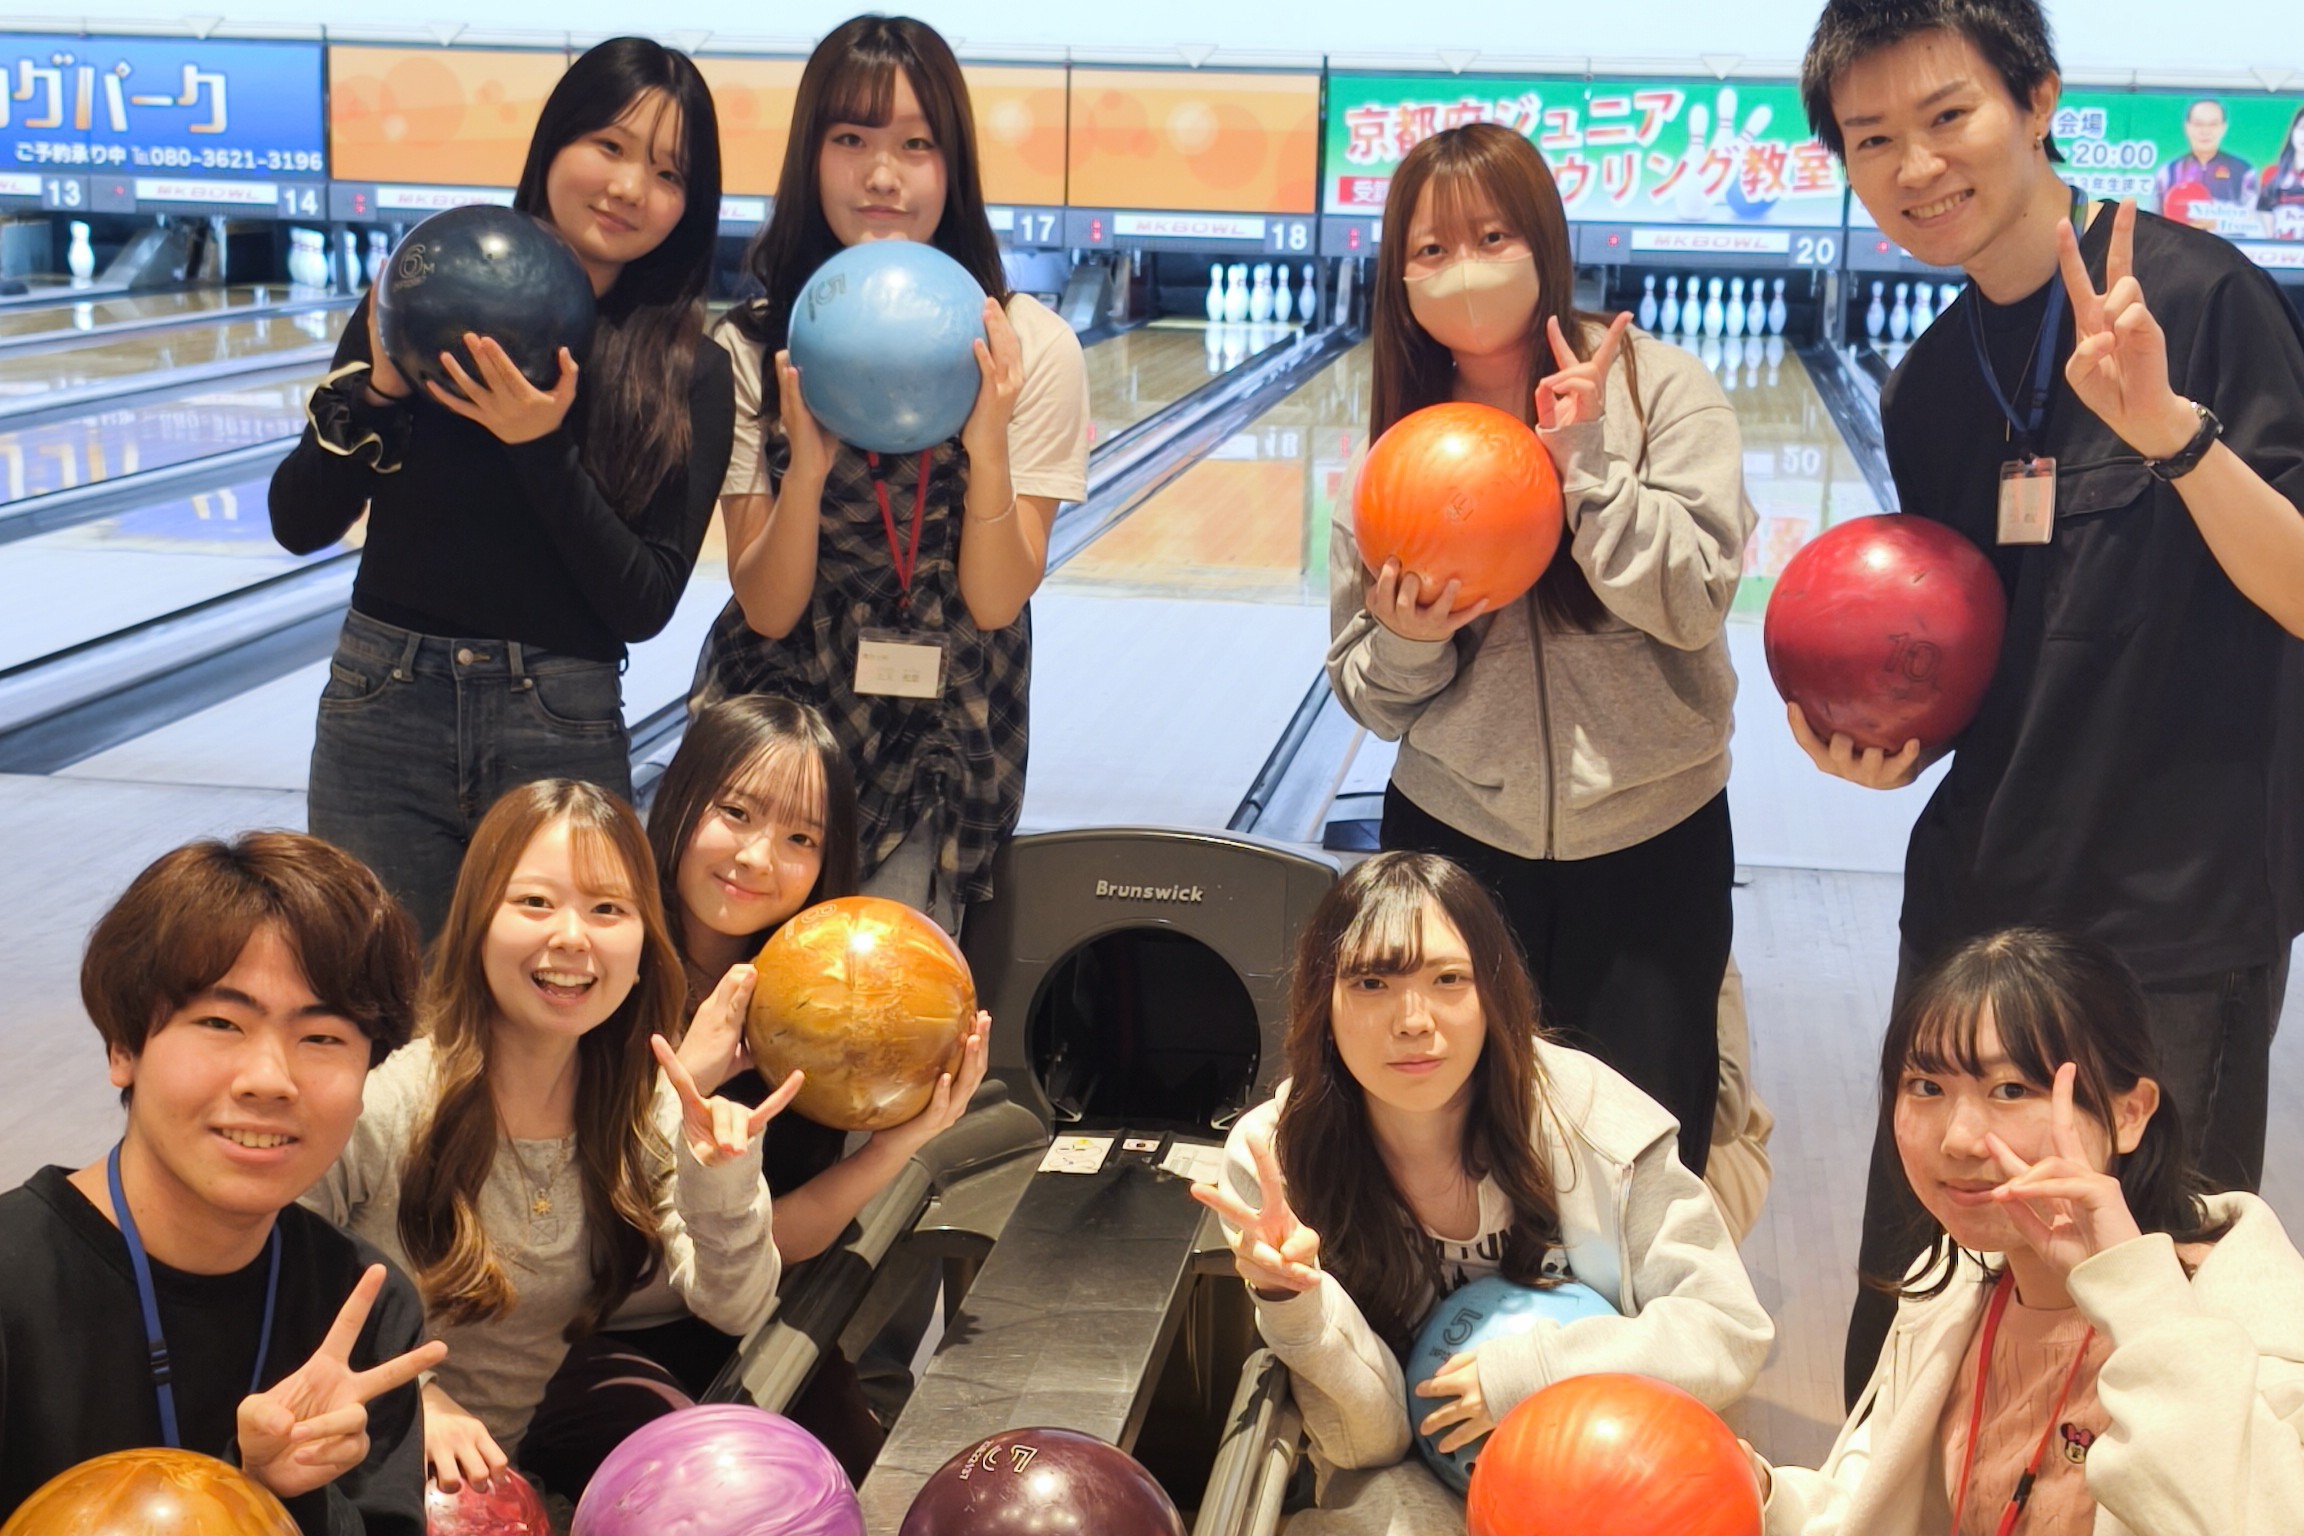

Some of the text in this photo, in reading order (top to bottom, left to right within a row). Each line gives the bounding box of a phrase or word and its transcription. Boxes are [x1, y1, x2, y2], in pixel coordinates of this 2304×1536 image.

[1550, 140, 1838, 202] ウリング教室
[48, 180, 82, 207] 13
[284, 188, 319, 216] 14
[1020, 214, 1056, 242] 17
[1271, 223, 1308, 251] 18
[1796, 238, 1836, 265] 20
[1095, 879, 1204, 902] Brunswick
[1443, 1308, 1484, 1346] 5
